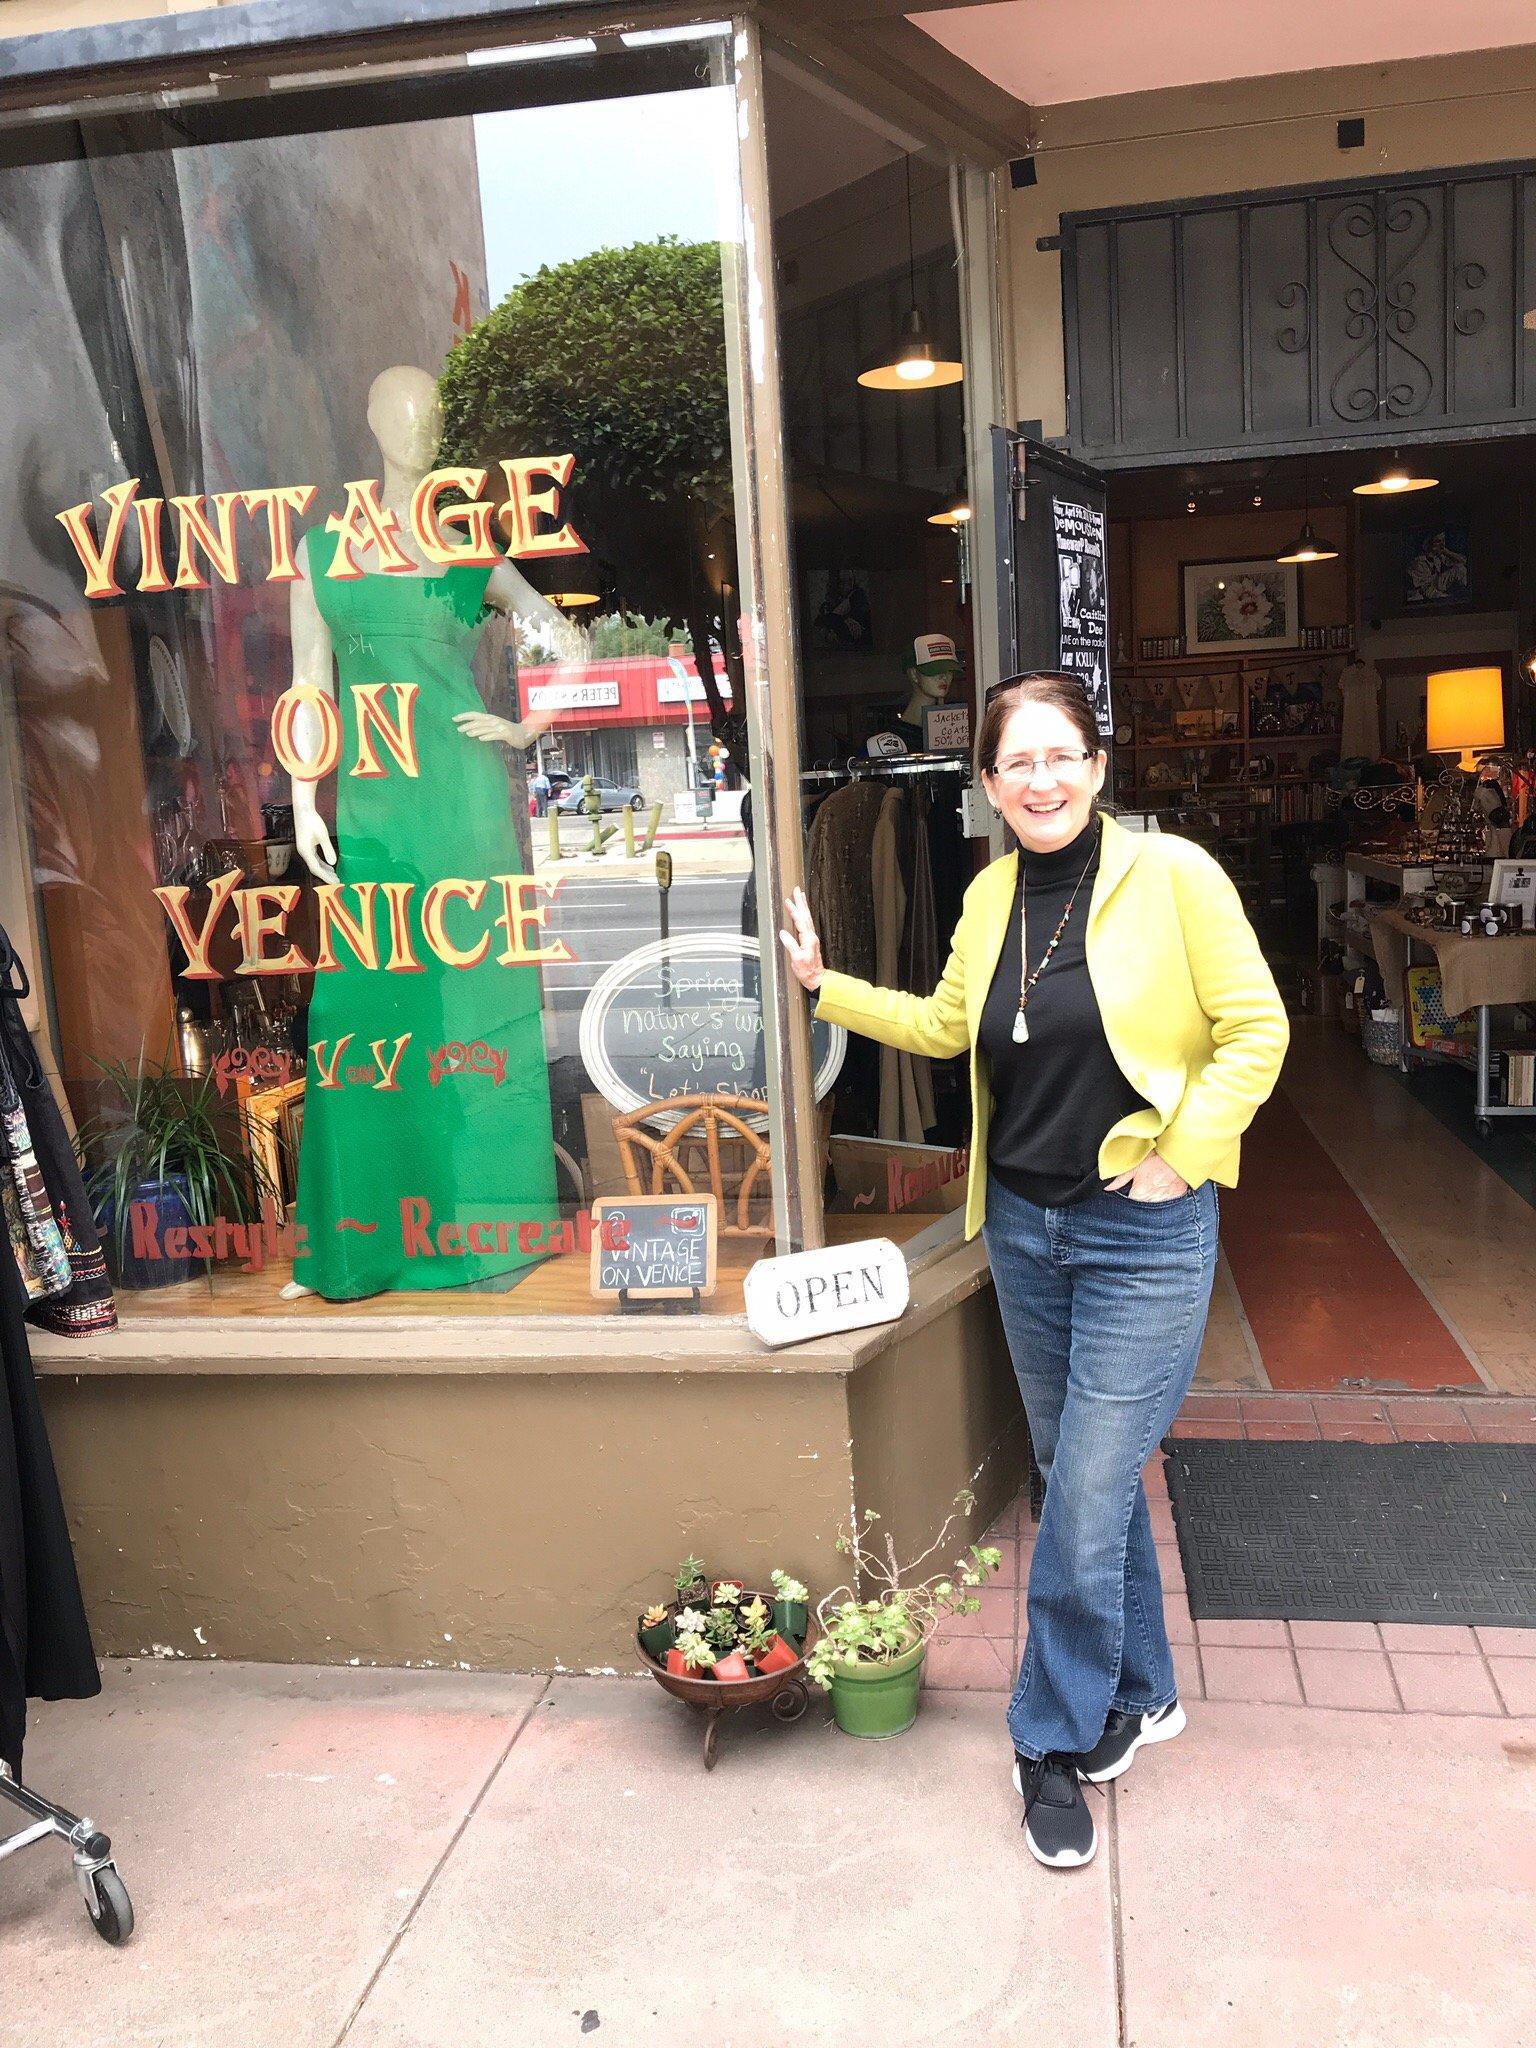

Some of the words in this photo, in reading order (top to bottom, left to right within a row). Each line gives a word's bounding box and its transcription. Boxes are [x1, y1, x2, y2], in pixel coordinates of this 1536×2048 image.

[55, 454, 590, 599] VINTAGE
[1080, 607, 1106, 621] Caitlin
[1088, 621, 1103, 635] Dee
[1072, 637, 1080, 646] on
[1080, 636, 1092, 647] the
[1075, 652, 1094, 667] KXLU
[271, 683, 419, 782] ON
[934, 735, 953, 746] 50%
[153, 869, 581, 979] VENICE
[654, 966, 740, 1013] Spring
[735, 1014, 765, 1034] wa
[658, 1035, 746, 1072] Saying
[886, 1146, 971, 1214] Reinve
[129, 1197, 311, 1274] Restyle
[400, 1197, 633, 1258] Recreate
[602, 1266, 630, 1286] ON
[775, 1265, 886, 1319] OPEN
